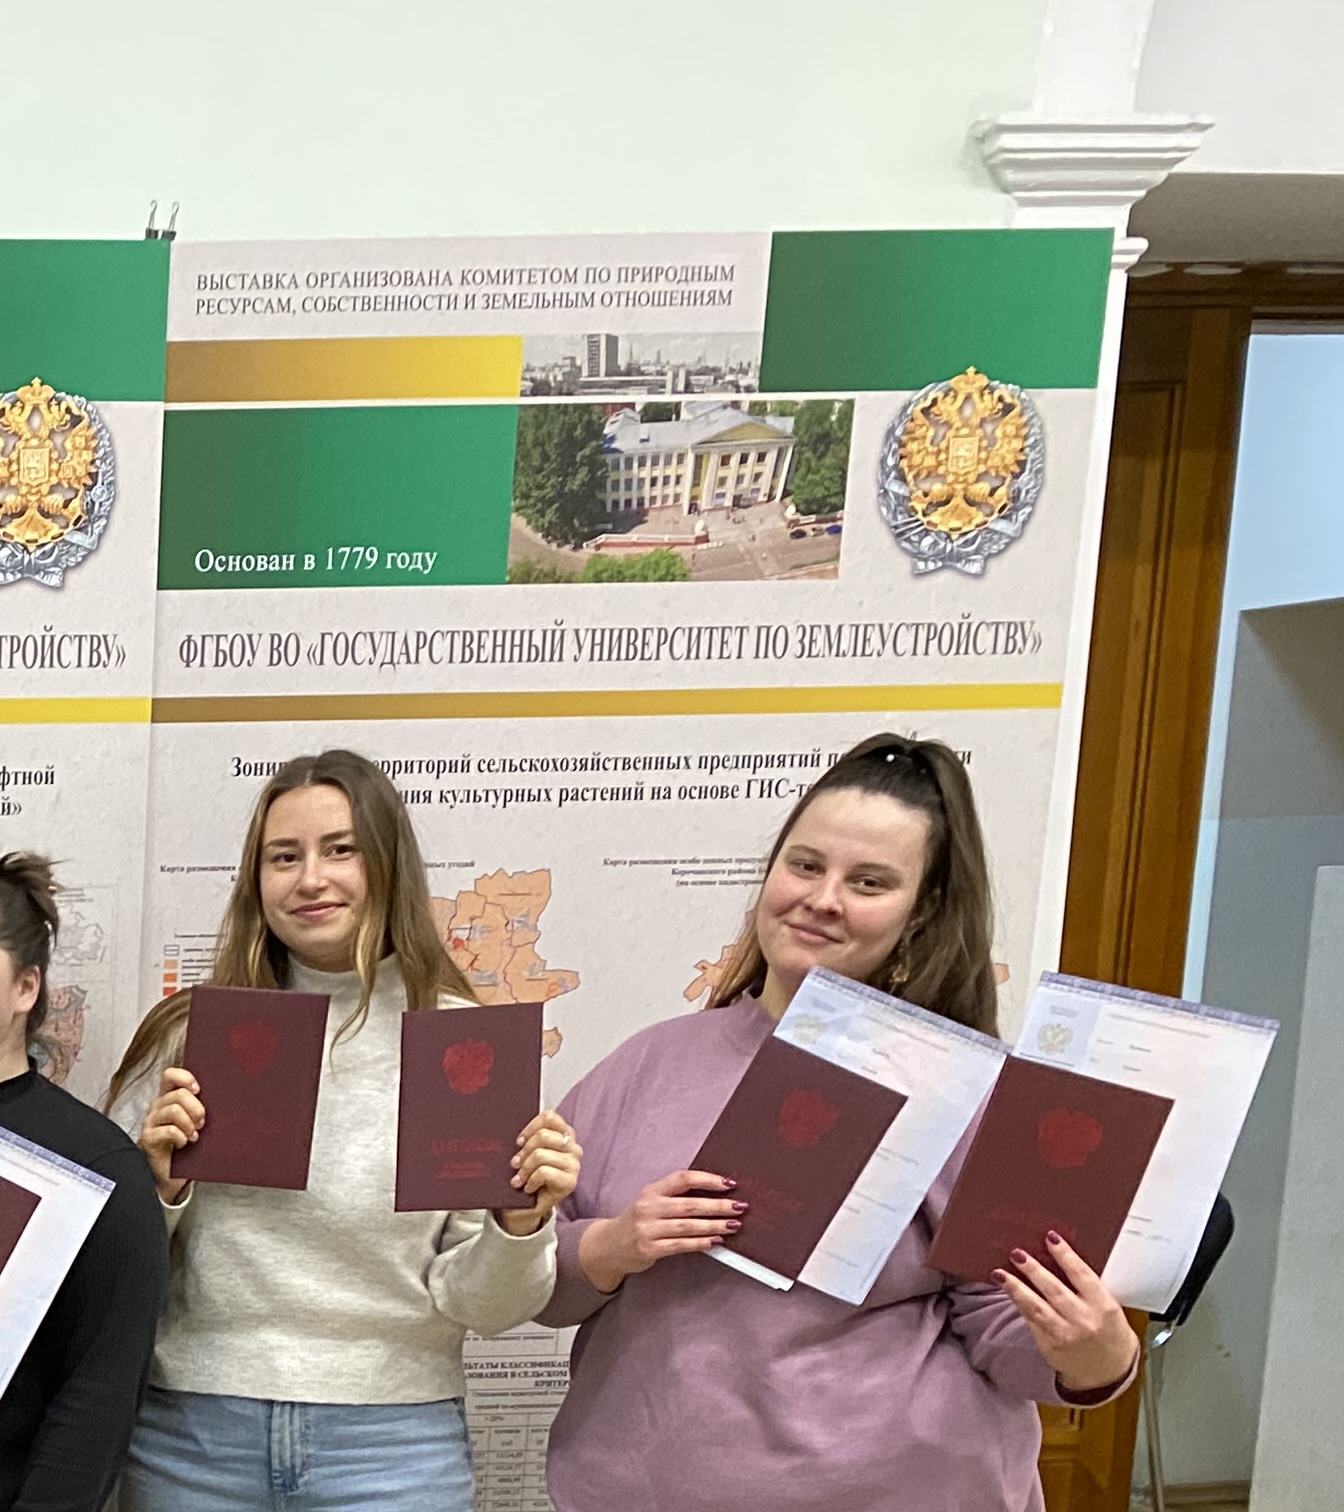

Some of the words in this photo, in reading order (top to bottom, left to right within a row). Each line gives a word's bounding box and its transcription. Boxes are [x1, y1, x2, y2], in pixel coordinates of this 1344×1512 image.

[197, 272, 298, 290] ВЫСТАВКА
[306, 269, 452, 288] ОРГАНИЗОВАНА
[460, 267, 578, 285] КОМИТЕТОМ
[585, 267, 610, 284] ПО
[617, 265, 734, 285] ПРИРОДНЫМ
[196, 296, 295, 316] РЕСУРСАМ,
[302, 293, 458, 312] СОБСТВЕННОСТИ
[464, 293, 476, 309] И
[482, 291, 595, 309] ЗЕМЕЛЬНЫМ
[600, 289, 732, 307] ОТНОШЕНИЯМ
[194, 548, 295, 572] Основан
[304, 554, 315, 569] в
[327, 546, 378, 569] 1779
[386, 552, 436, 574] году
[179, 633, 261, 669] ФГБОУ
[268, 632, 300, 667] ВО
[307, 620, 565, 672] «ГОСУДАРСТВЕННЫЙ
[573, 625, 748, 662] УНИВЕРСИТЕТ
[754, 624, 788, 659] ПО
[795, 612, 1041, 658] ЗЕМЛЕУСТРОЙСТВУ»
[386, 754, 470, 777] рриторий
[477, 750, 690, 772] сельскохозяйственных
[698, 748, 820, 774] предприятий
[439, 788, 551, 809] культурных
[558, 781, 643, 807] растений
[650, 786, 671, 799] на
[678, 785, 739, 799] основе
